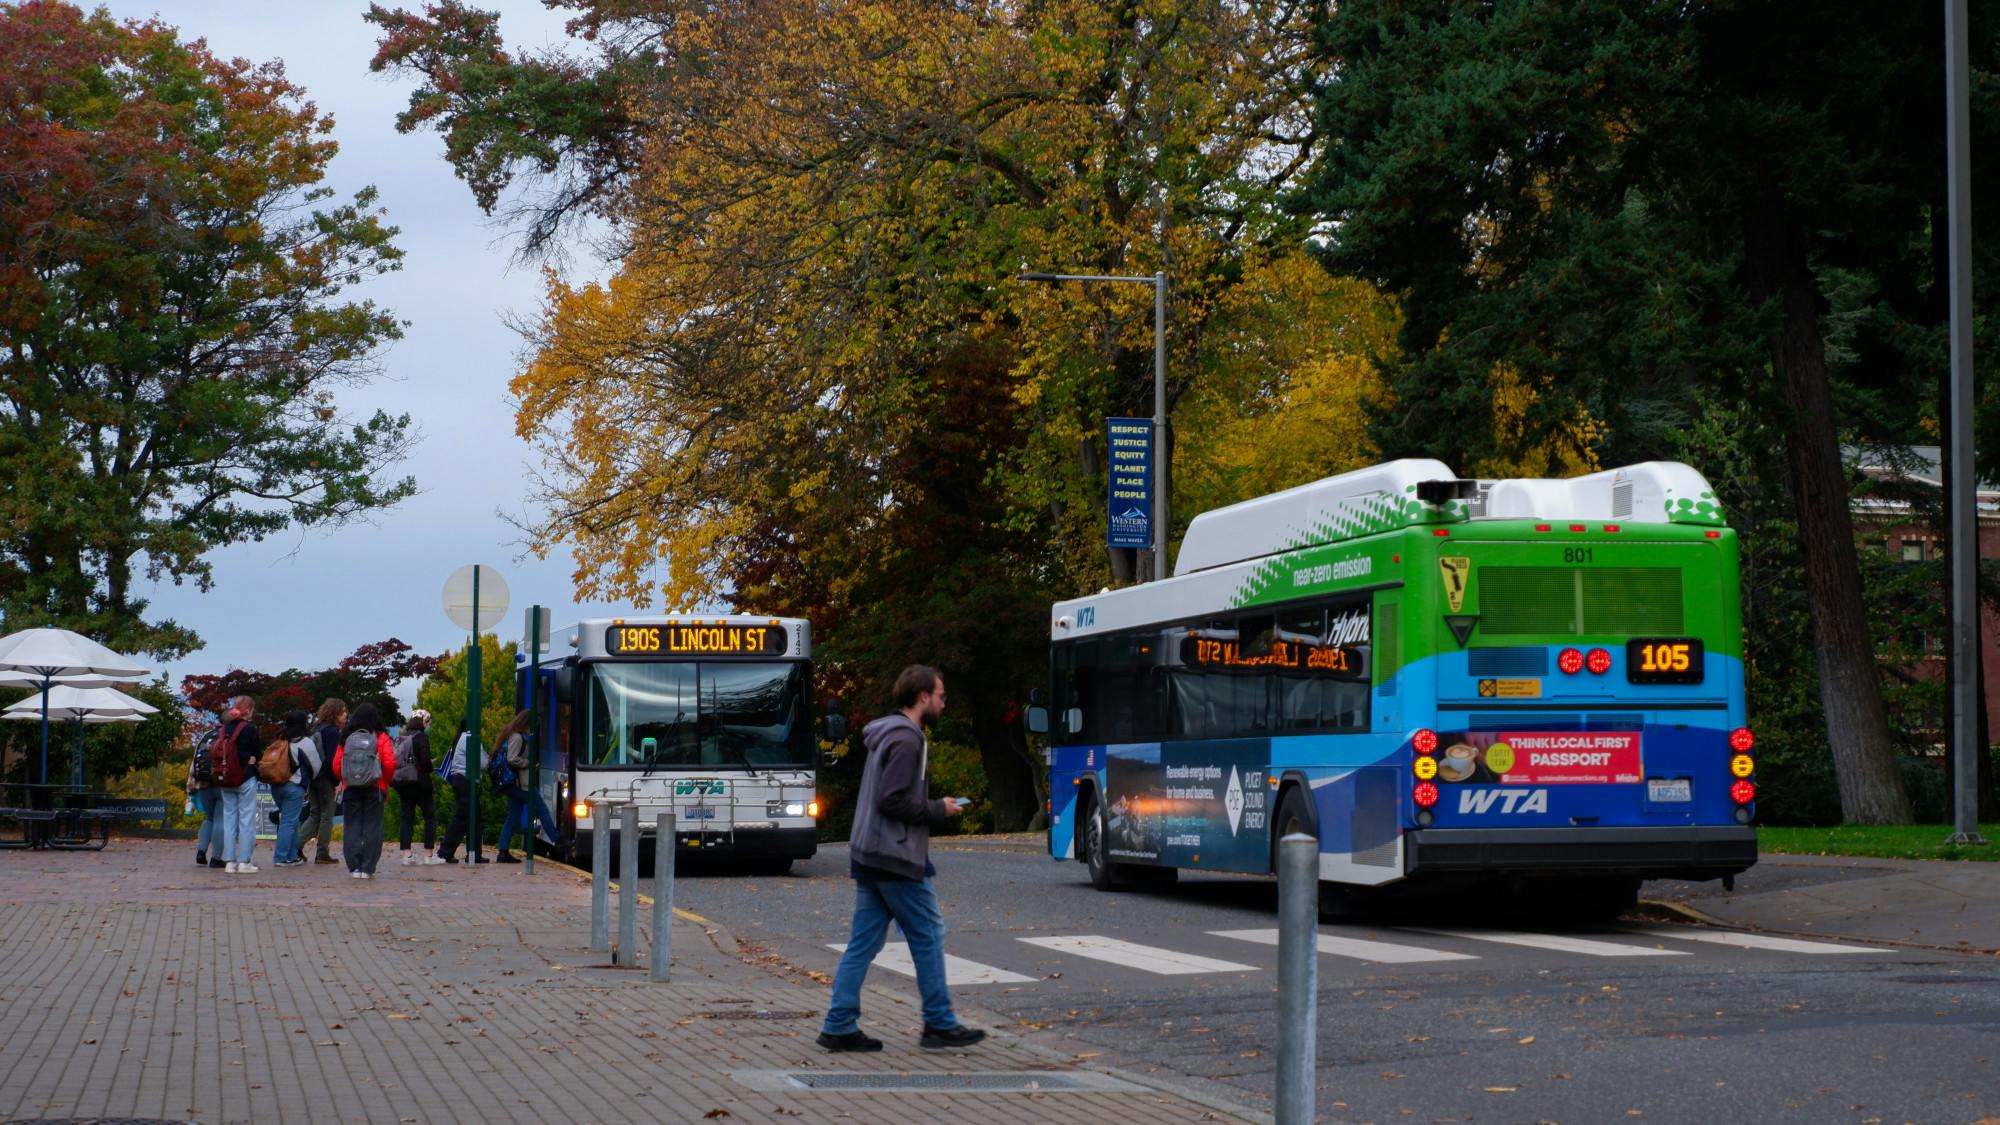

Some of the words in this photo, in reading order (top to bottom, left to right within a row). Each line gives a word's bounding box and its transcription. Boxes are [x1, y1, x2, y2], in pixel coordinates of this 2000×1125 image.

[1113, 439, 1148, 447] JUSTICE
[1114, 451, 1145, 460] EQUITY
[1114, 464, 1147, 473] PLANET
[1116, 477, 1144, 486] PLACE
[1113, 490, 1147, 499] PEOPLE
[1111, 515, 1149, 524] WESTERN
[1563, 547, 1594, 563] 801
[1293, 563, 1332, 588] near-zero
[1333, 552, 1372, 580] emission
[1077, 605, 1095, 628] WTA
[670, 628, 741, 651] LINCOLN
[746, 628, 766, 651] ST
[1641, 644, 1690, 671] 105
[1508, 737, 1549, 750] THINK
[1550, 737, 1594, 750] LOCAL
[1594, 737, 1632, 749] FIRST
[1529, 752, 1612, 767] PASSPORT
[1166, 765, 1189, 778] Renewable
[1189, 767, 1204, 781] energy
[1204, 765, 1222, 780] options
[1245, 772, 1262, 788] PUGET
[1173, 785, 1185, 799] home
[1185, 785, 1194, 799] and
[1228, 789, 1241, 811] PSE
[1245, 792, 1264, 808] SOUND
[1458, 789, 1548, 814] WTA
[1245, 812, 1265, 829] ENERGY
